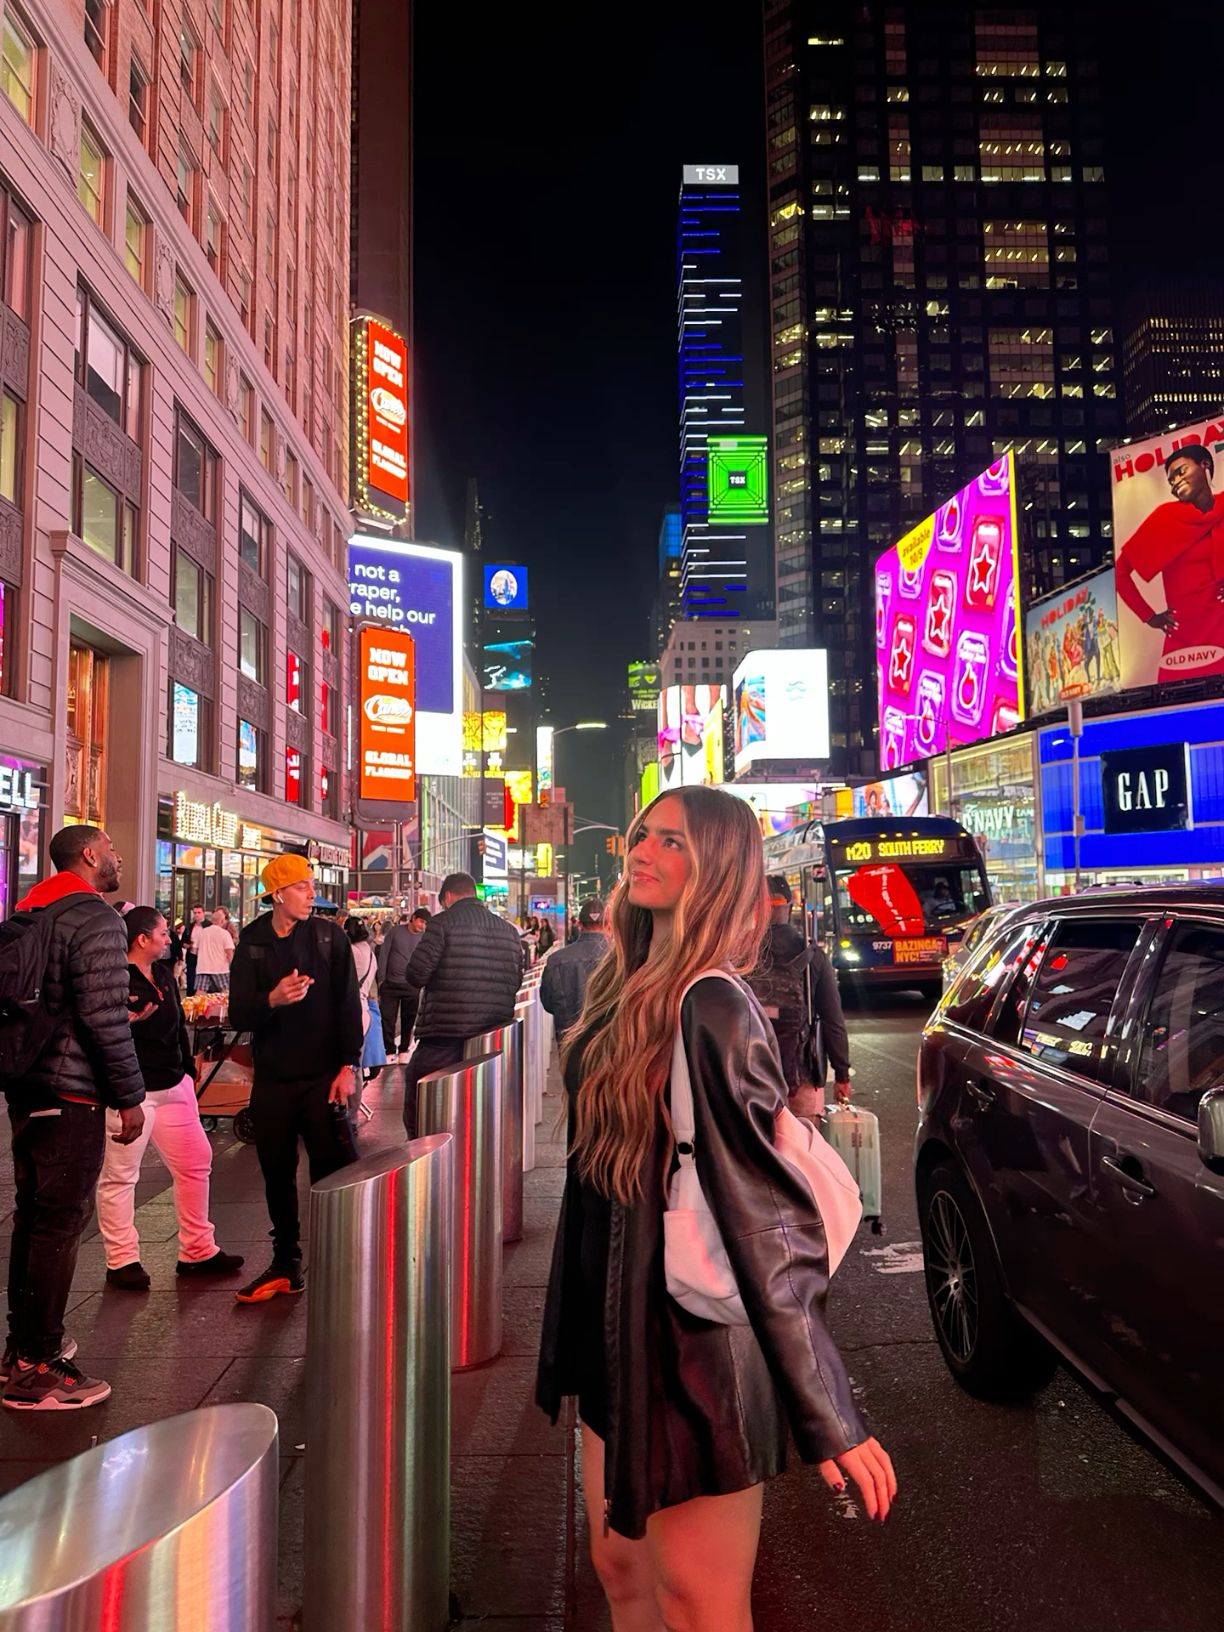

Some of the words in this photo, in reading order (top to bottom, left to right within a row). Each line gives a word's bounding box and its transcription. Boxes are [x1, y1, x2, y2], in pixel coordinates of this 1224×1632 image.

[695, 168, 726, 181] TSX
[1113, 453, 1132, 465] also
[1114, 418, 1224, 484] HOLIDA
[729, 475, 746, 485] TSX
[354, 563, 386, 581] not
[388, 569, 401, 582] a
[348, 582, 401, 604] raper,
[365, 600, 405, 622] help
[406, 610, 437, 625] our
[1040, 586, 1088, 628] HOLIDAY
[369, 647, 408, 669] NOW
[1165, 655, 1186, 667] OLD
[1187, 649, 1217, 663] NAVY
[367, 665, 409, 686] OPEN
[631, 699, 657, 710] WICKE
[365, 750, 413, 768] GLOBAL
[1117, 768, 1170, 812] GAP
[974, 805, 1014, 834] NAVY
[845, 842, 871, 860] M20
[878, 841, 911, 857] SOUTH
[911, 839, 945, 855] FERRY
[848, 914, 874, 924] 166
[872, 941, 893, 950] 9737
[896, 951, 919, 963] NYC!
